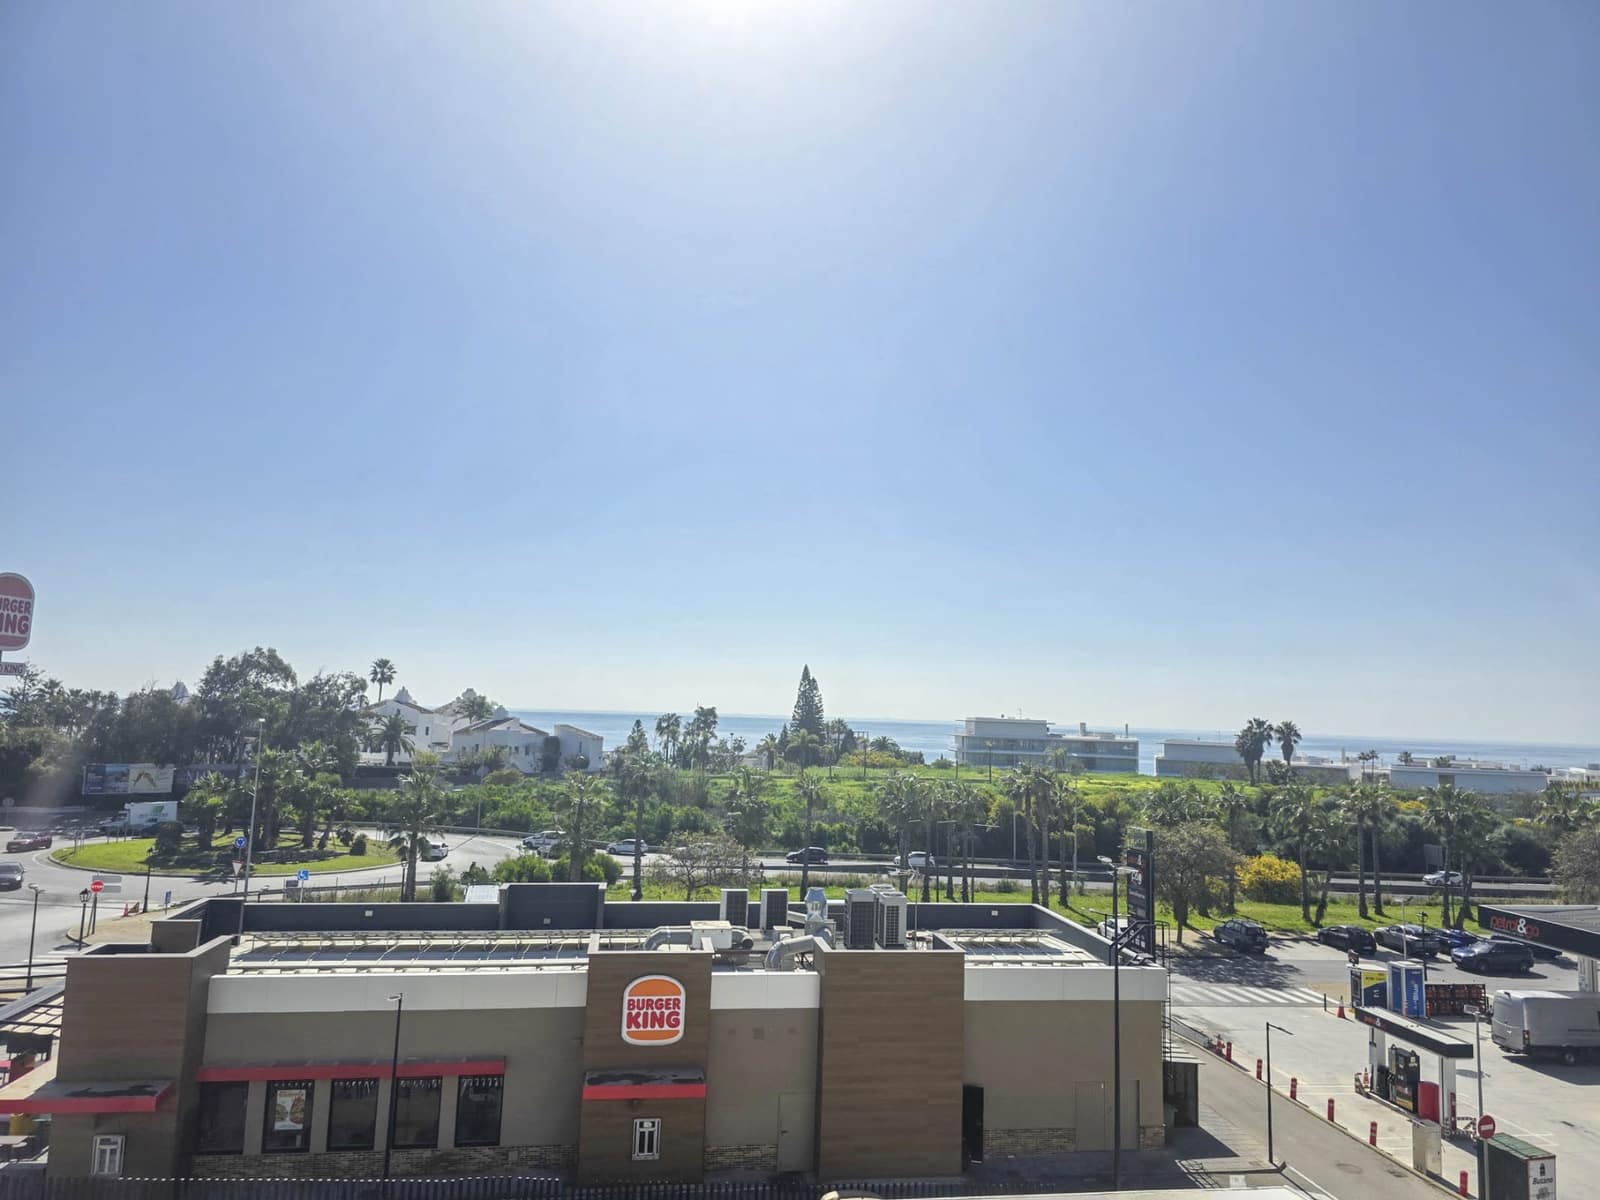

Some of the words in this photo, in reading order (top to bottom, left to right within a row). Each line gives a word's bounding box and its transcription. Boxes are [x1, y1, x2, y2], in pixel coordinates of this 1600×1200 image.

[0, 597, 31, 614] RGER
[0, 612, 29, 635] ING
[627, 998, 681, 1011] BURGER
[626, 1011, 681, 1029] KING
